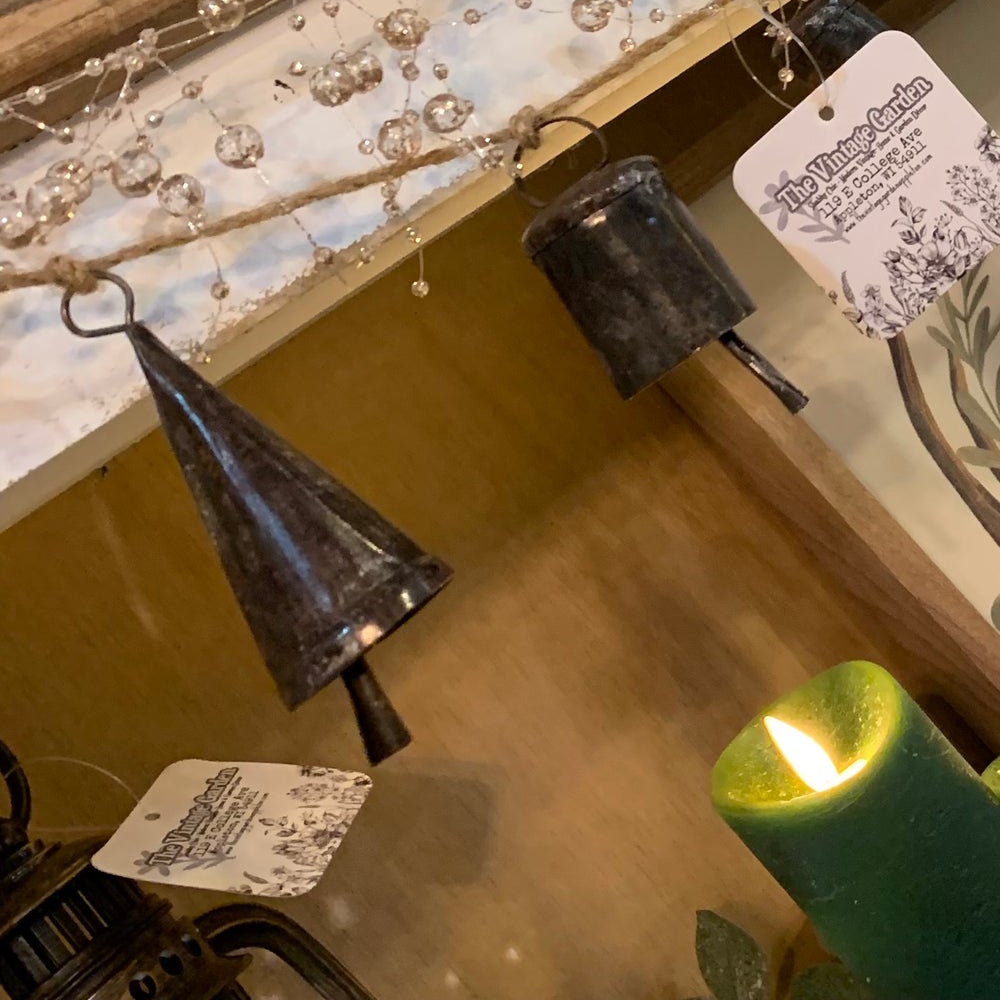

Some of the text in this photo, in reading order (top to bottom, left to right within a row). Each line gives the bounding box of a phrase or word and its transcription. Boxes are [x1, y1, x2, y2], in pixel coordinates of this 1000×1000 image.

[774, 76, 934, 214] The Vintage Garden
[819, 127, 923, 219] 119 E College Ave
[833, 140, 927, 225] Appleton, WI 54911
[193, 766, 239, 804] Garden
[144, 843, 184, 866] The
[162, 803, 213, 844] Vintage
